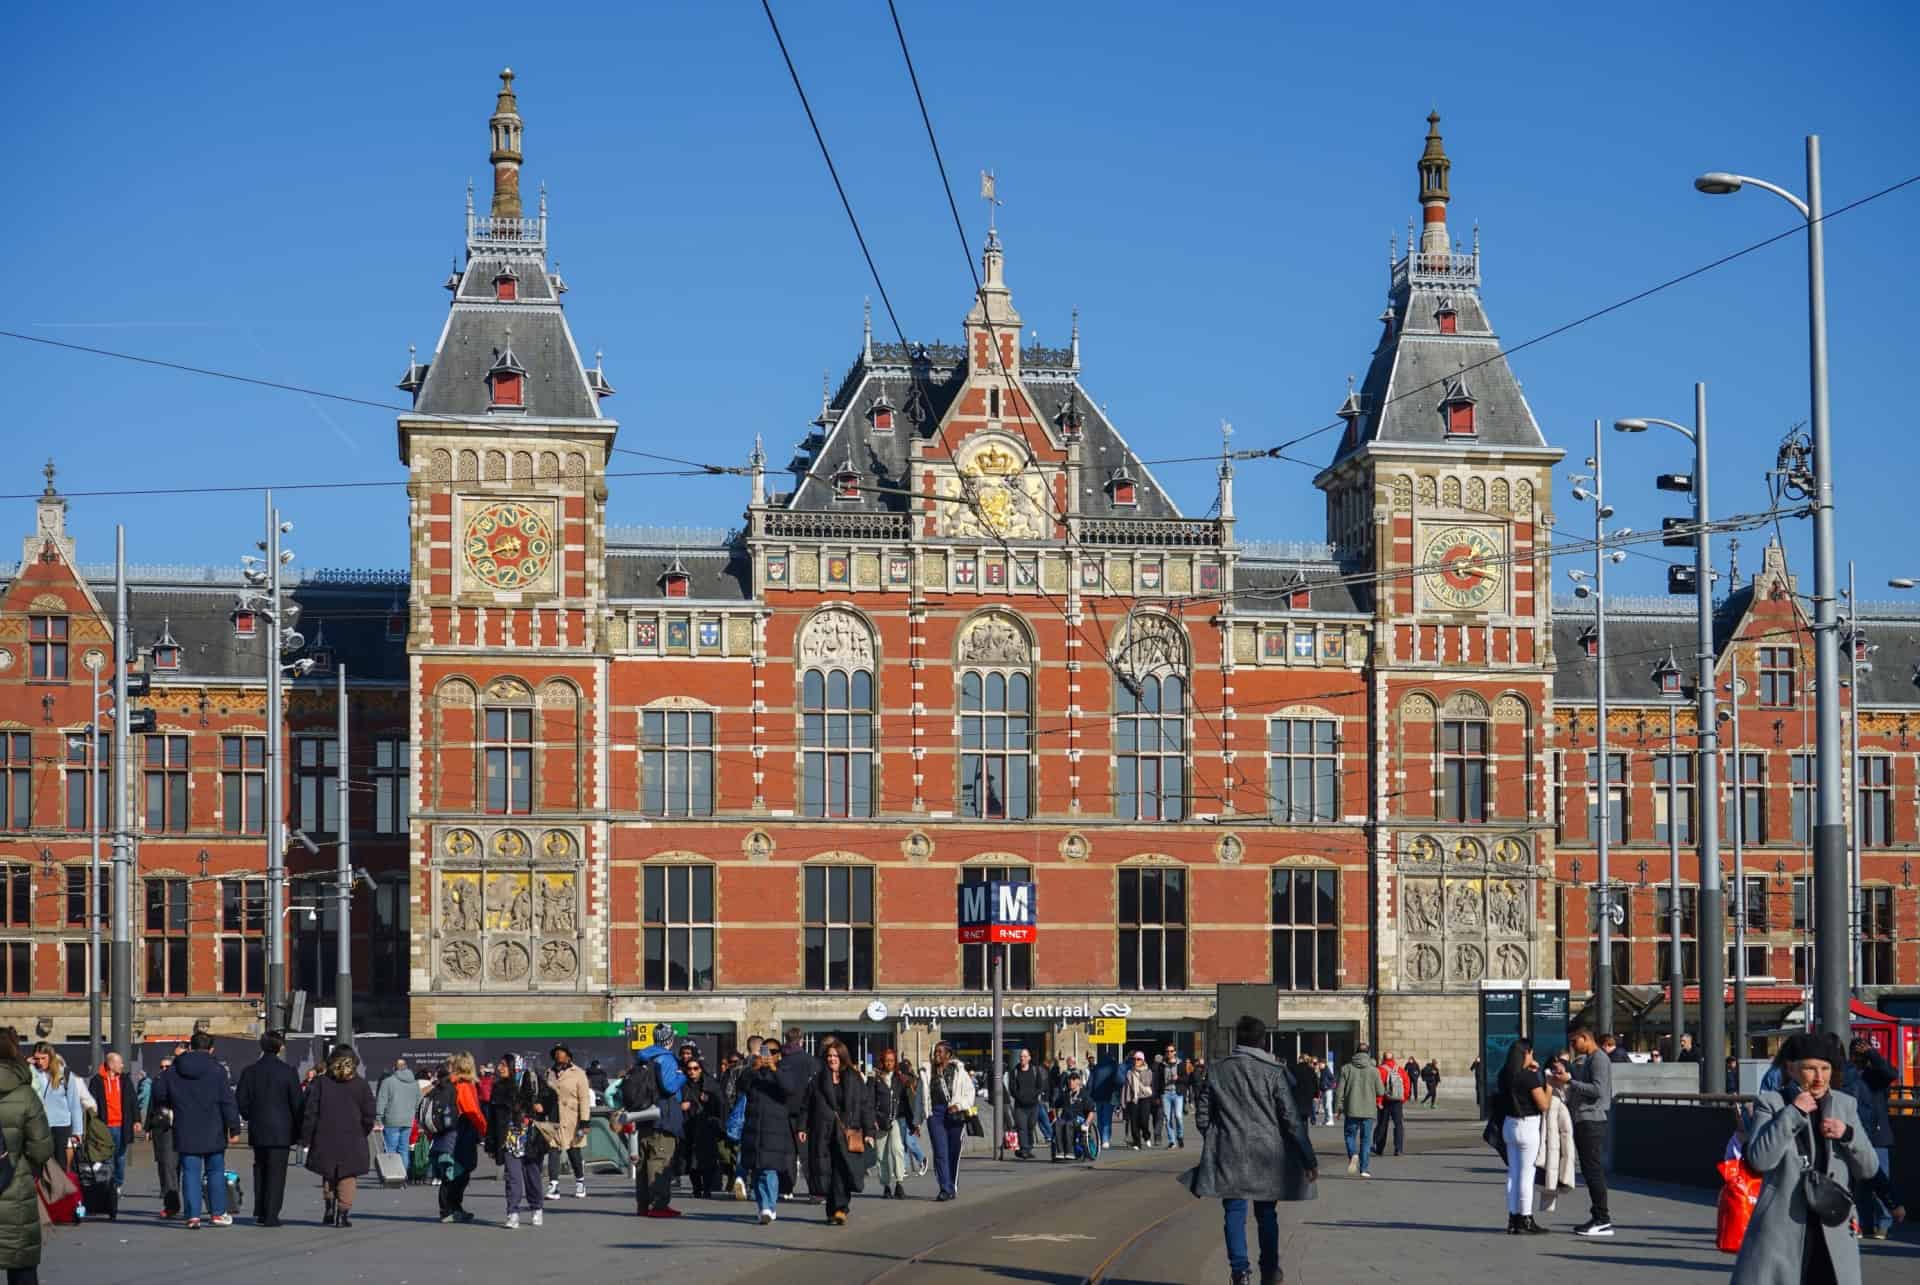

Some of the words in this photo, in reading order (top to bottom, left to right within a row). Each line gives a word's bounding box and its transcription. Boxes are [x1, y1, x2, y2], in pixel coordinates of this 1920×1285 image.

[963, 886, 985, 922] M
[999, 885, 1028, 922] M
[1011, 1002, 1089, 1018] Centraal
